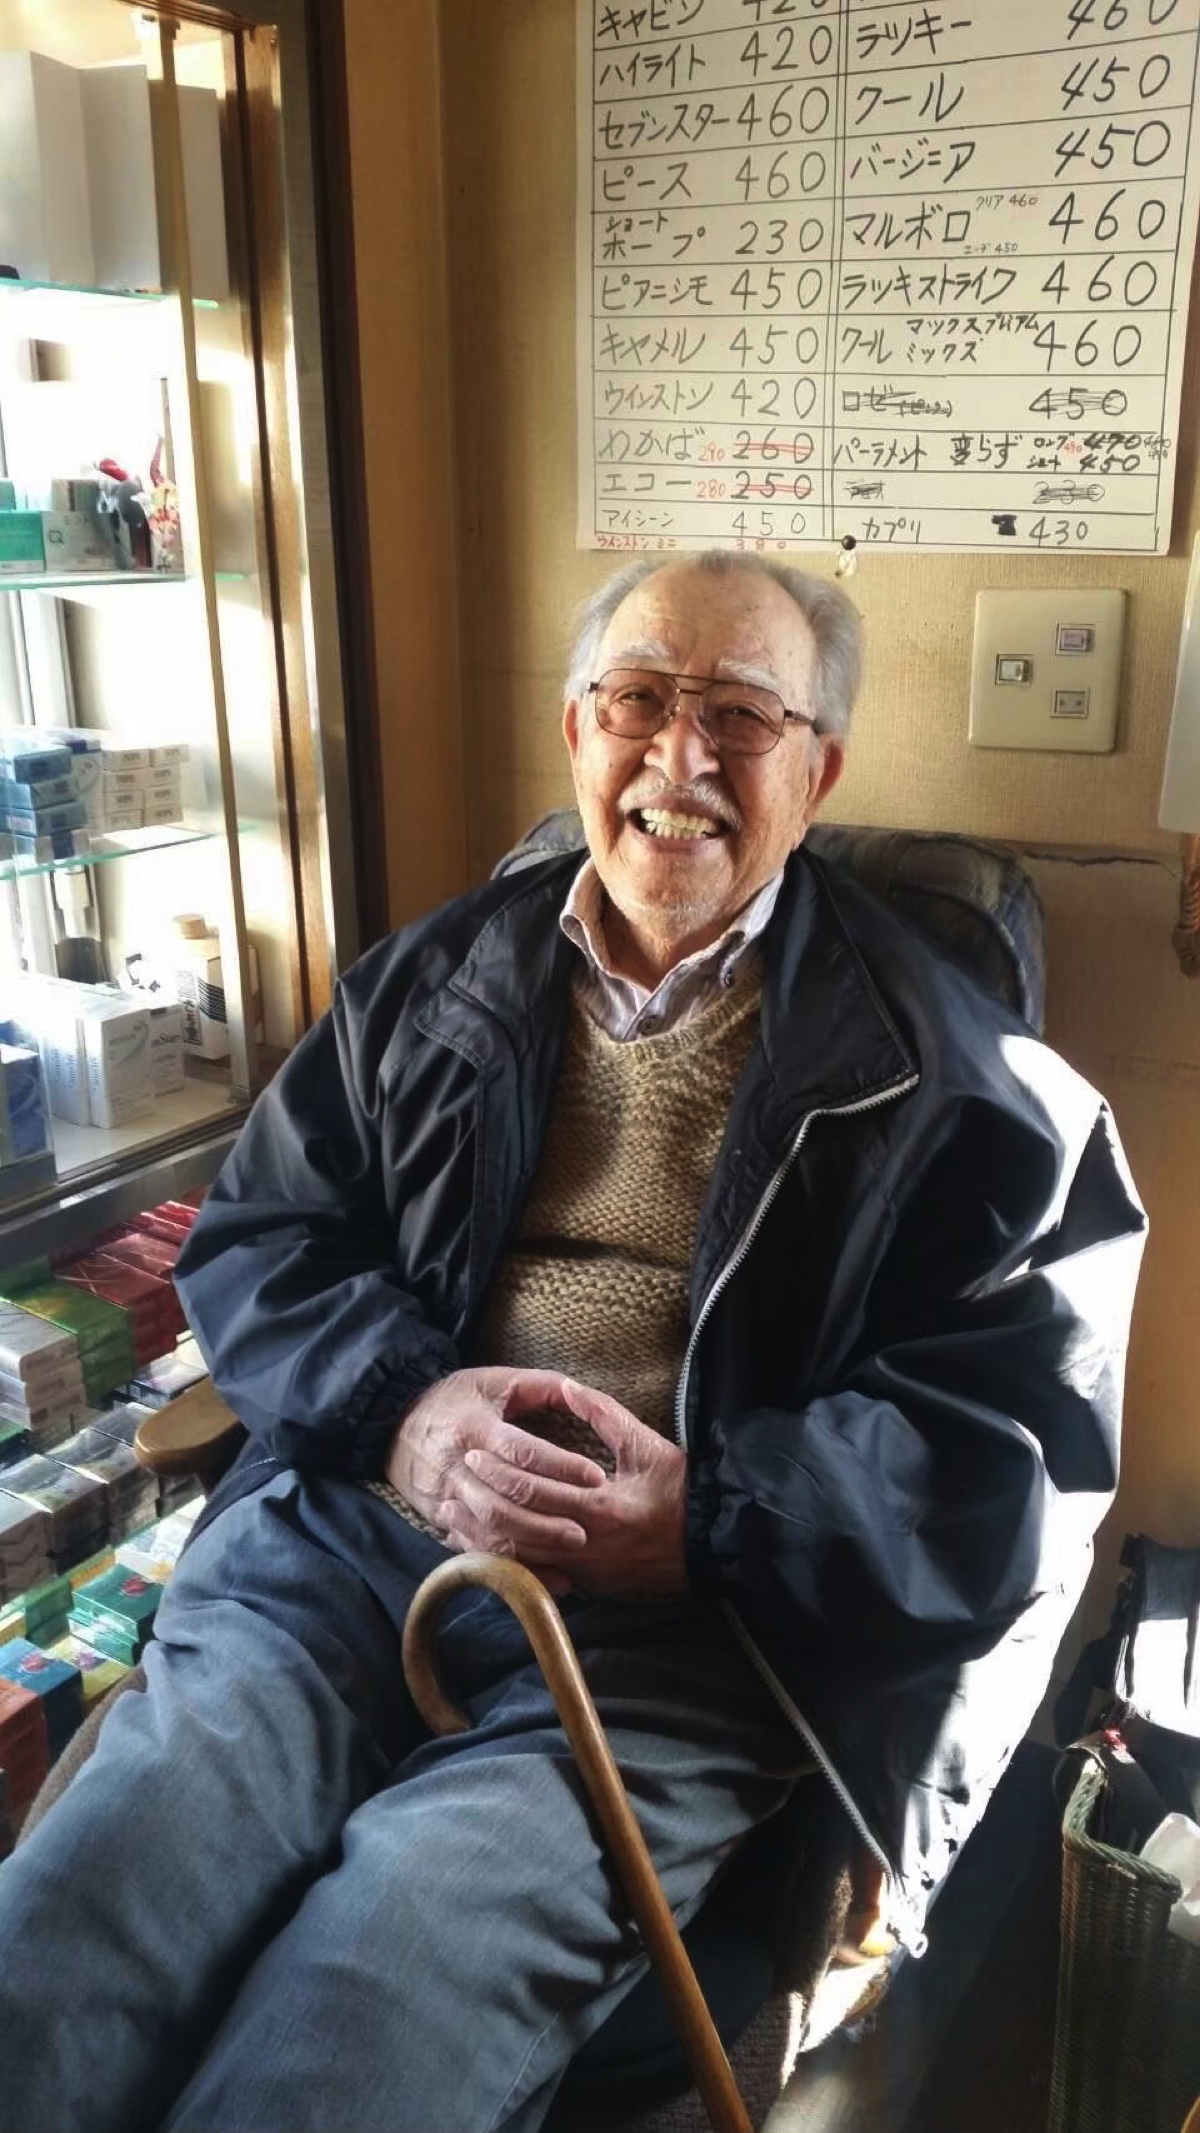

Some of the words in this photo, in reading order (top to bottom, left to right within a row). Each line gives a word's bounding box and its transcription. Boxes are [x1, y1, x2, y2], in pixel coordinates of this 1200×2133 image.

[600, 43, 705, 89] ハイライト
[740, 25, 832, 77] 420
[855, 72, 965, 125] クール
[1061, 54, 1171, 111] 450
[598, 103, 731, 149] セブンスター
[737, 84, 829, 141] 460
[850, 137, 976, 184] バージニア
[1055, 120, 1171, 178] 450
[603, 162, 692, 201] ピース
[735, 150, 826, 201] 460
[845, 201, 971, 250] マルボロ
[1048, 188, 1166, 245] 460
[1009, 193, 1039, 208] 460
[603, 226, 706, 260] ホープ
[735, 218, 824, 255] 230
[602, 273, 712, 310] ピアニシモ
[730, 266, 823, 310] 450
[1041, 255, 1157, 306] 460
[599, 323, 706, 366] キャメル
[730, 323, 820, 368] 450
[841, 327, 893, 364] クール
[1034, 319, 1142, 372] 460
[731, 377, 817, 419] 420
[599, 428, 706, 461] わかば
[732, 428, 815, 464] 260
[834, 434, 928, 471] パーラメント
[602, 473, 692, 492] エコー
[696, 478, 727, 499] 280
[730, 470, 815, 500] 250
[602, 509, 675, 528] アイシーン
[730, 510, 807, 537] 450
[862, 517, 922, 544] カプリ
[1029, 516, 1089, 547] 430
